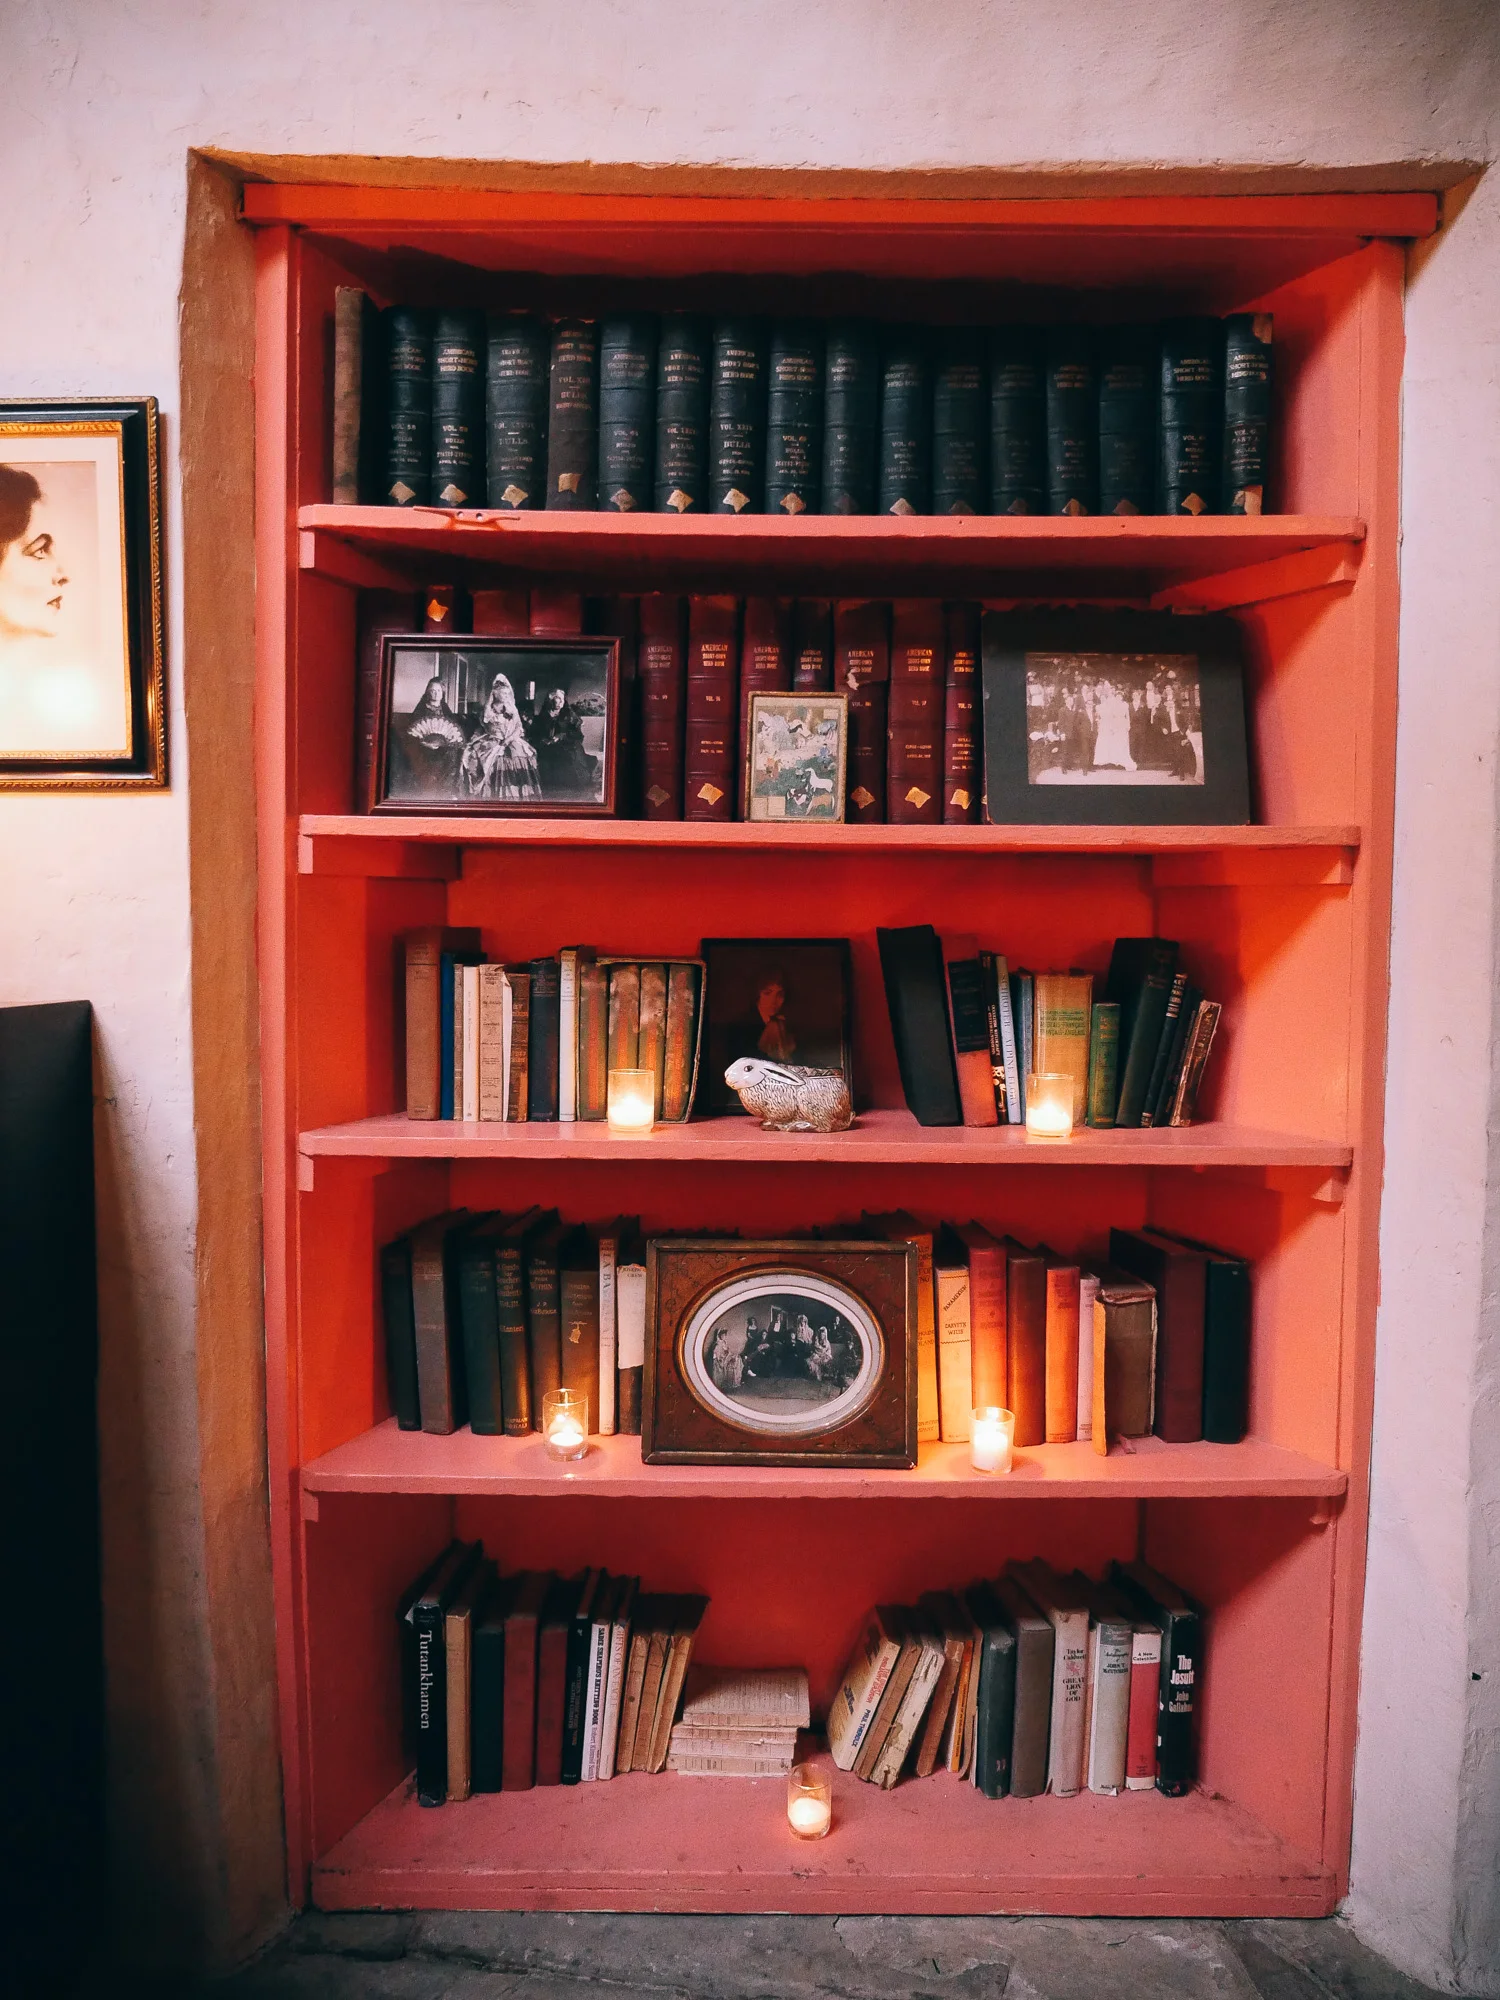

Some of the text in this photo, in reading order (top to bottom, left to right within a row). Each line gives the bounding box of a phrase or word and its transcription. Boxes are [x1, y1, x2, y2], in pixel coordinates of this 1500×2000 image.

[614, 1653, 622, 1666] OF
[1177, 1655, 1192, 1670] The
[419, 1630, 433, 1729] Tutankhamen
[1170, 1669, 1196, 1685] Jesuit
[1175, 1691, 1190, 1702] John
[592, 1709, 600, 1726] BOOK
[851, 1708, 872, 1747] PAUL THEROUX
[590, 1728, 598, 1744] Robert
